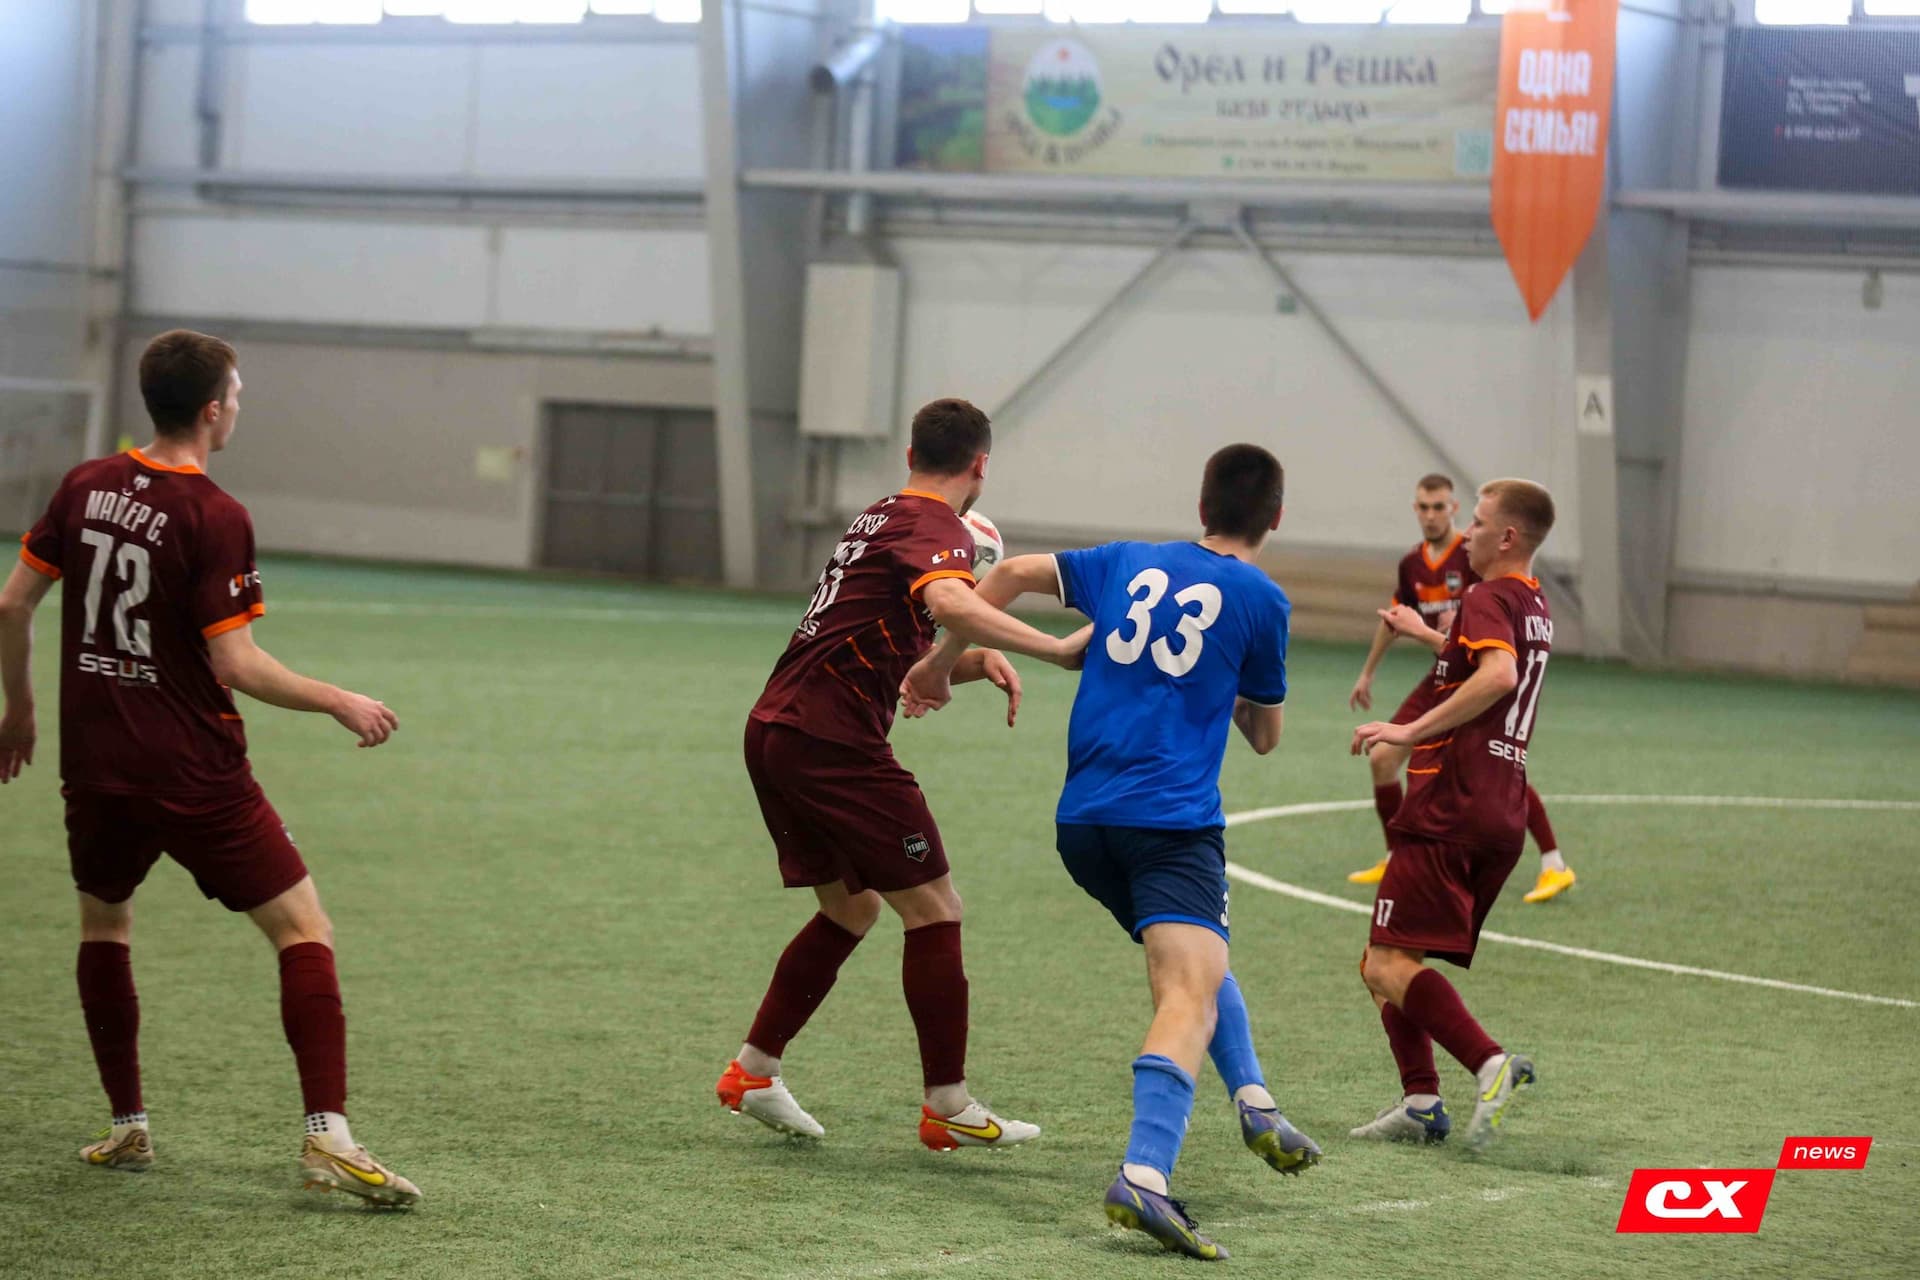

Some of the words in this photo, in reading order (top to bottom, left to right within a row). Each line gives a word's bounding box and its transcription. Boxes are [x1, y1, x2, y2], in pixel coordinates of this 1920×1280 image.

[1518, 48, 1592, 100] ОДНА
[1503, 108, 1599, 157] СЕМЬЯ!
[145, 511, 169, 546] С.
[80, 528, 152, 658] 72
[1106, 568, 1223, 678] 33
[78, 652, 159, 684] SEUS
[1504, 649, 1549, 742] 17
[1376, 898, 1394, 928] 17
